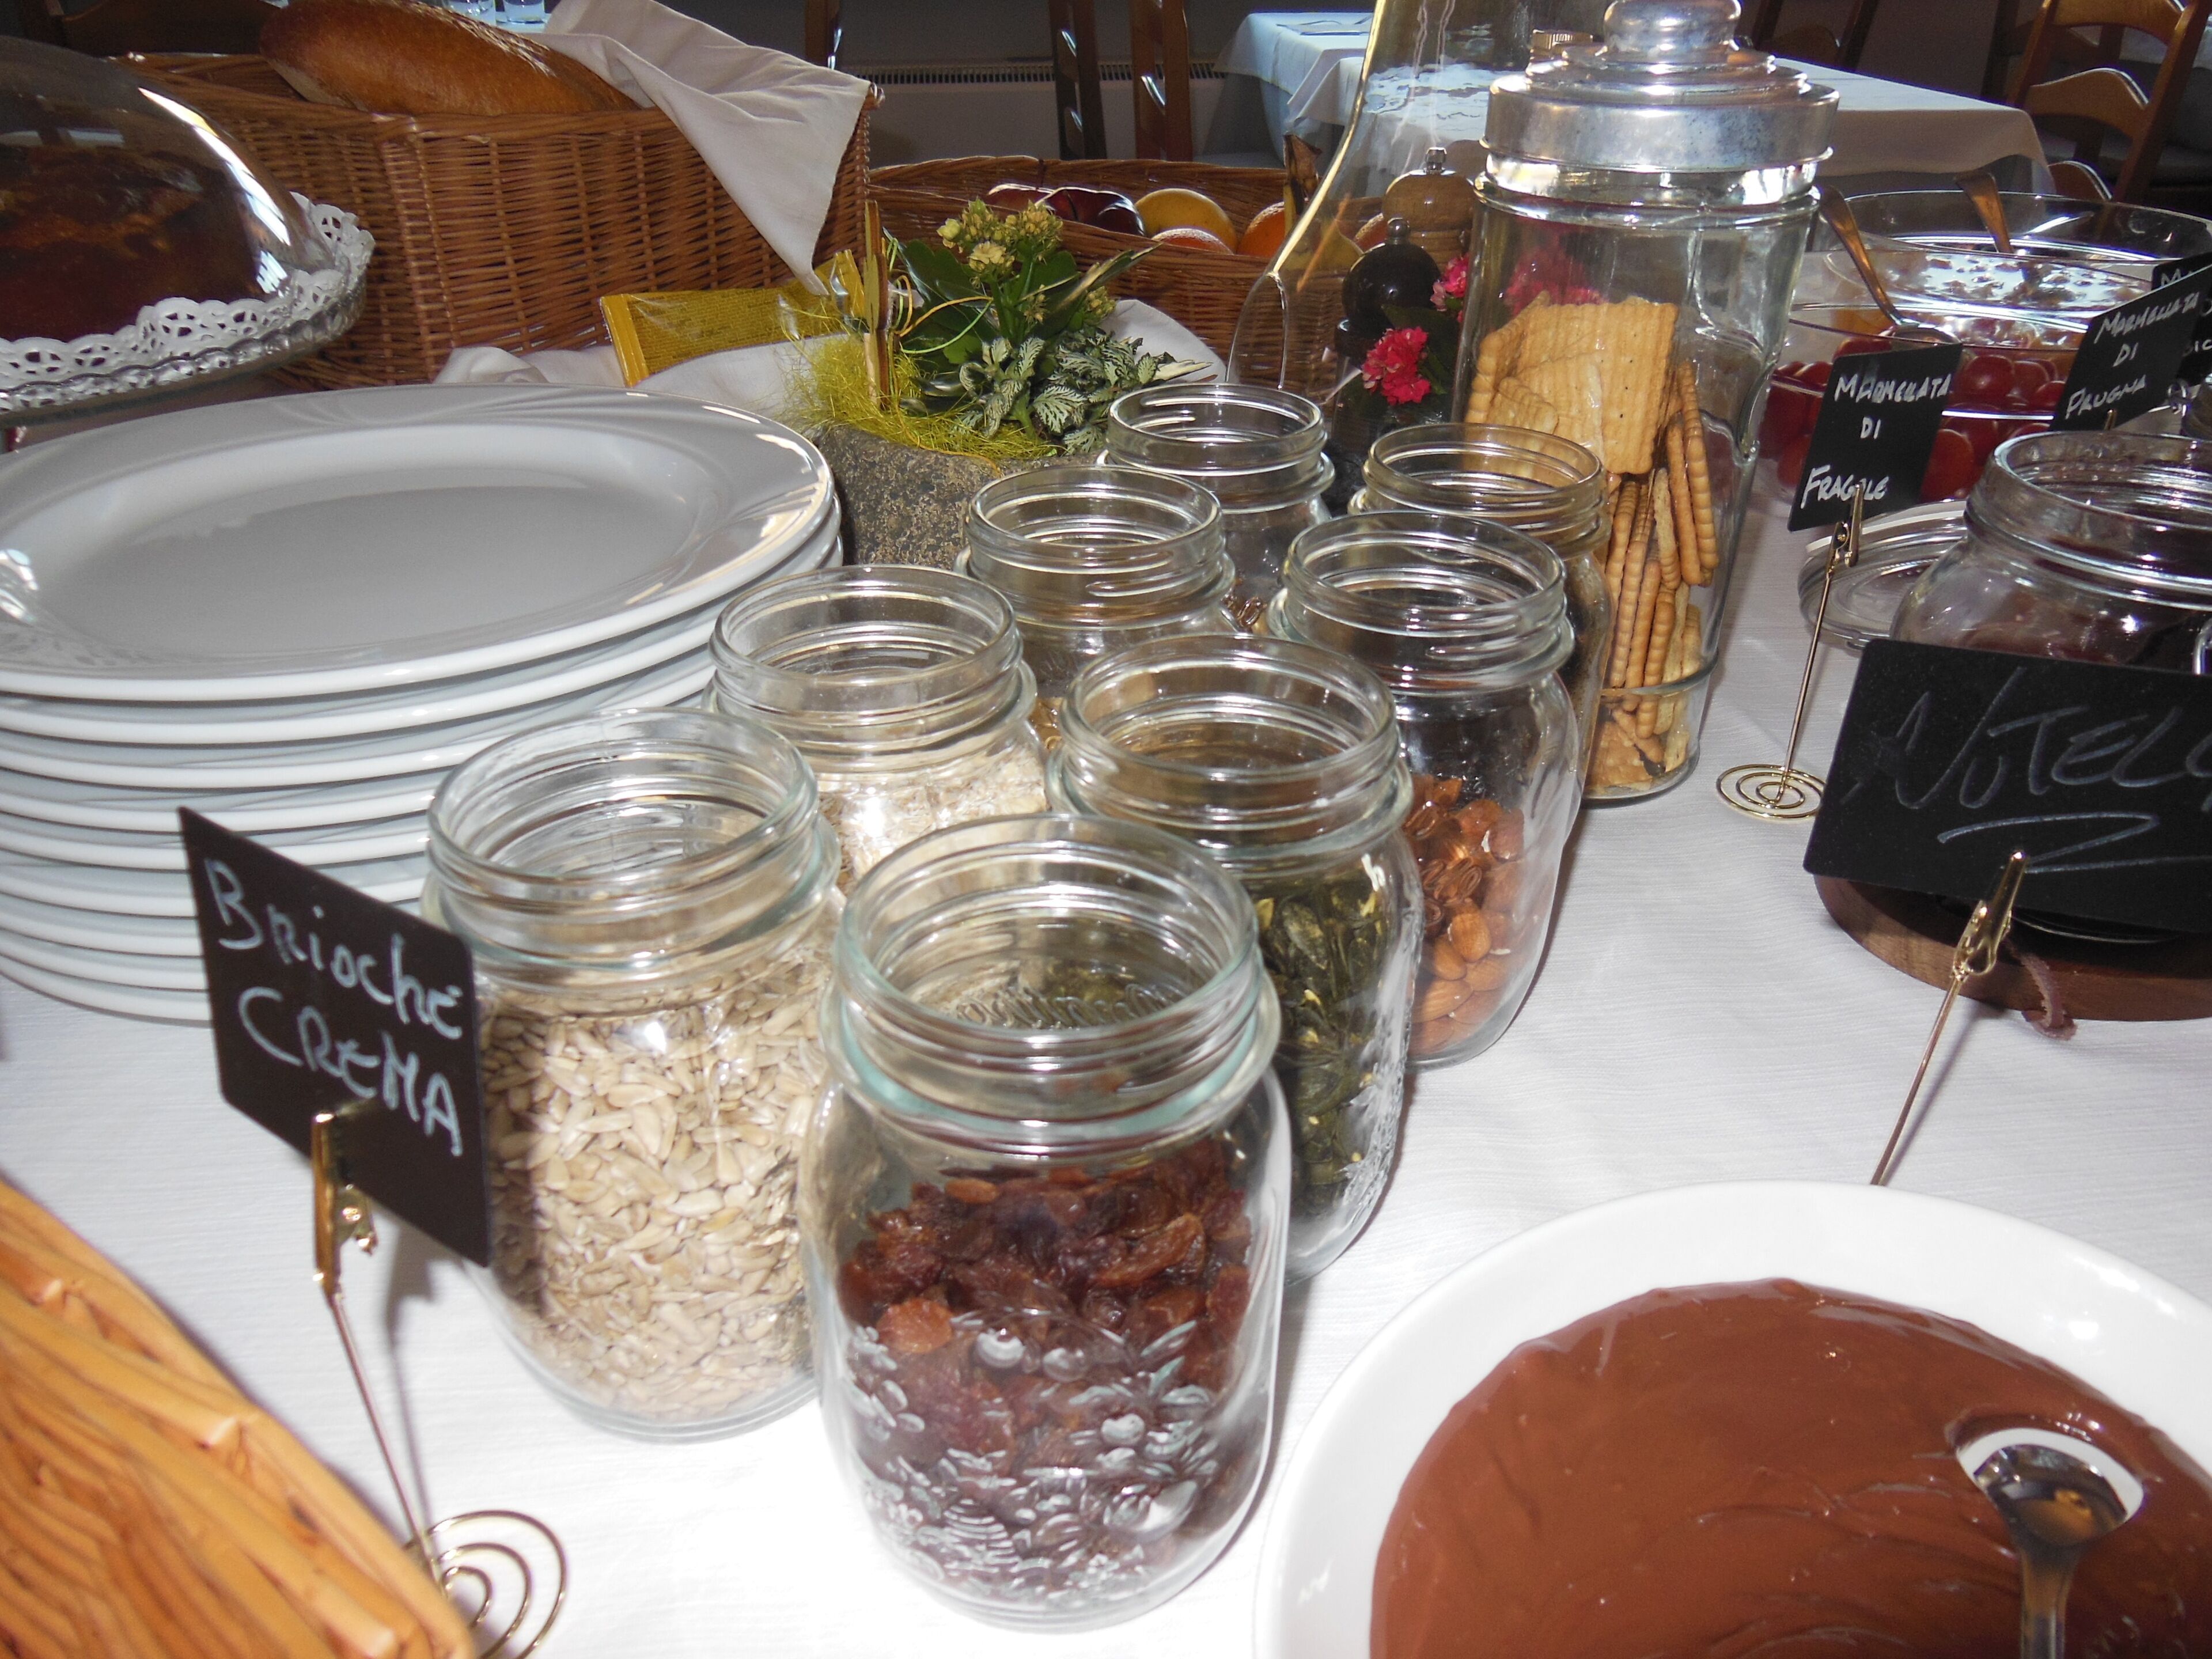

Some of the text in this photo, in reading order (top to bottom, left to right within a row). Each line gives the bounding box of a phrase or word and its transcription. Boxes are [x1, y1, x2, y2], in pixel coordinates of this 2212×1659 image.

[2112, 342, 2139, 367] DI
[1859, 416, 1881, 440] DI
[238, 986, 463, 1157] CREMA
